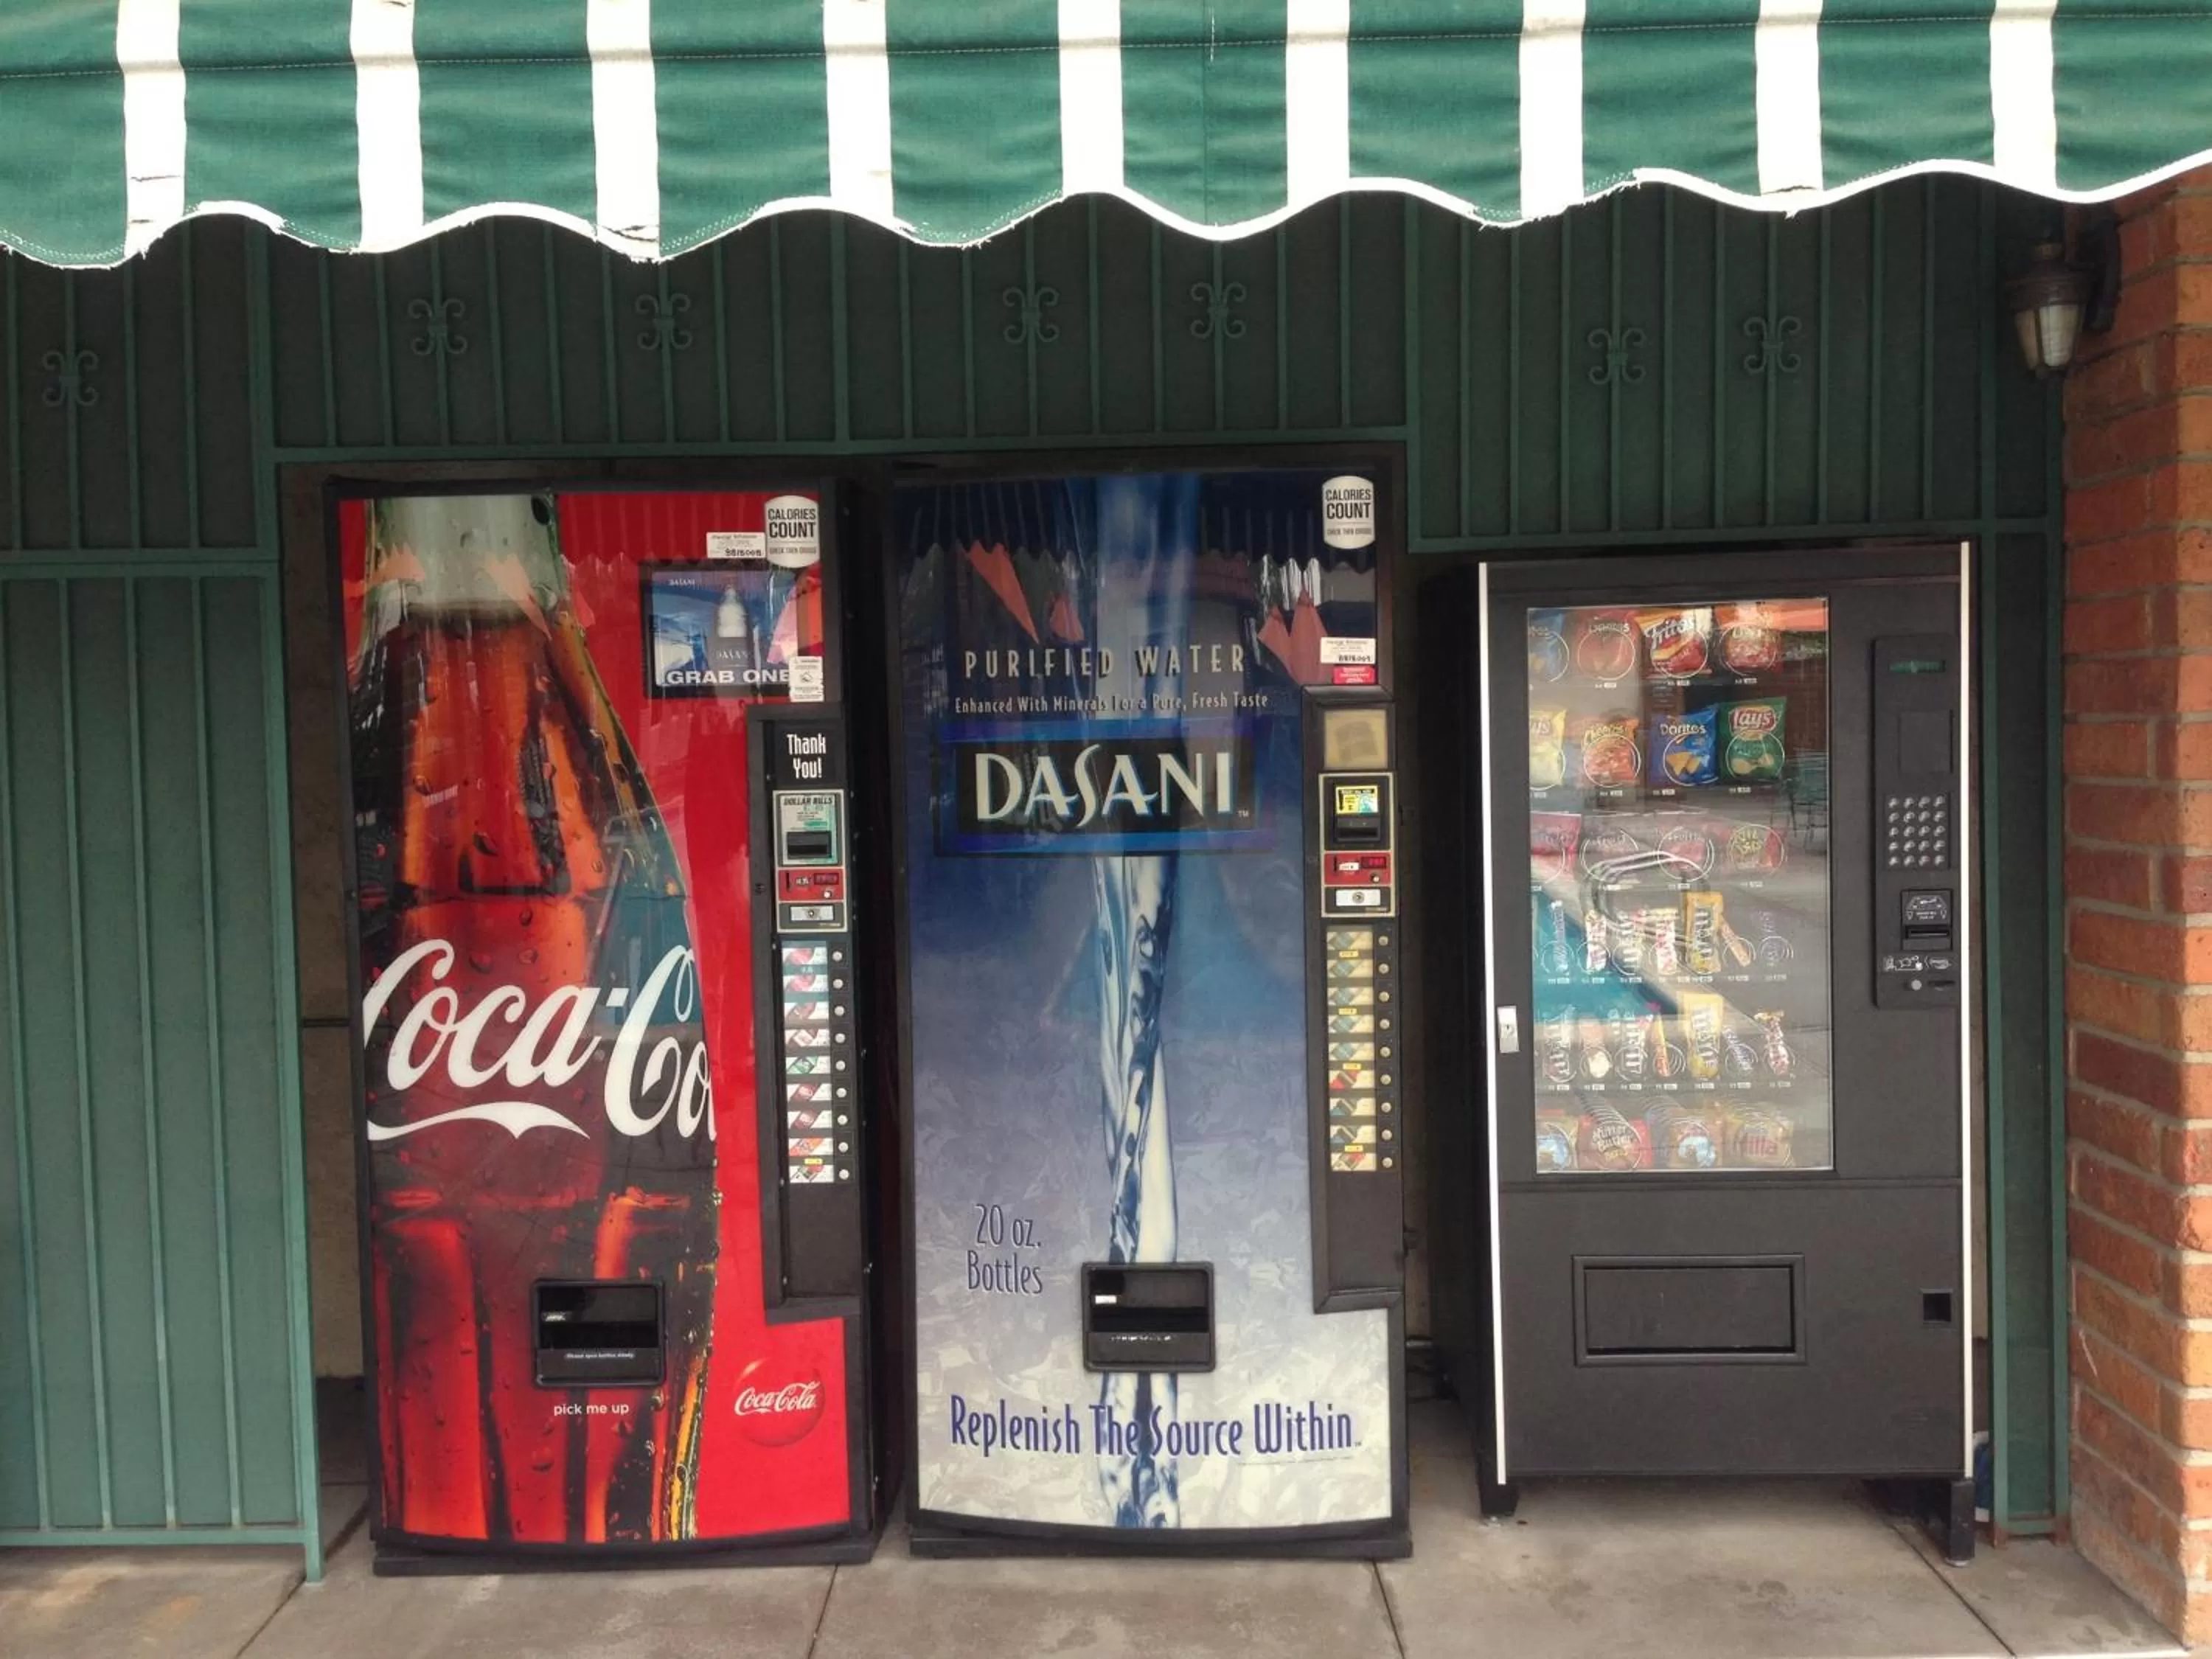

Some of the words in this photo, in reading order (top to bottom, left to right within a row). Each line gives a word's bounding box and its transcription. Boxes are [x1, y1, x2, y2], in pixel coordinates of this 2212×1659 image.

[1325, 490, 1371, 501] CALORIES
[768, 507, 816, 520] CALORIES
[1326, 502, 1371, 519] COUNT
[769, 521, 816, 538] COUNT
[1644, 617, 1695, 649] Fritos
[964, 647, 1115, 679] PURIFIED
[1135, 644, 1246, 676] WATER
[667, 669, 734, 684] GRAB
[742, 669, 789, 684] ONE
[955, 697, 1012, 714] Enhanced
[1017, 696, 1048, 712] With
[1053, 695, 1108, 713] Minerals
[1112, 695, 1133, 712] For
[1152, 694, 1188, 712] Pure,
[1192, 692, 1228, 708] Fresh
[1233, 691, 1270, 707] Taste
[1660, 723, 1707, 736] Doritos
[787, 733, 827, 754] Thank
[793, 757, 823, 779] You!
[975, 743, 1231, 827] DASANI
[783, 797, 812, 806] DOLLAR
[813, 796, 832, 805] BILLS
[975, 1203, 1004, 1246] 20
[1012, 1215, 1042, 1248] oz.
[967, 1250, 1043, 1295] Bottles
[734, 1381, 821, 1416] Coca-Cola
[554, 1403, 582, 1417] pick
[586, 1405, 608, 1414] me
[612, 1405, 629, 1416] up
[950, 1394, 1080, 1458] Replenish
[1088, 1403, 1139, 1456] The
[1151, 1405, 1242, 1457] Source
[1254, 1401, 1353, 1455] Within
